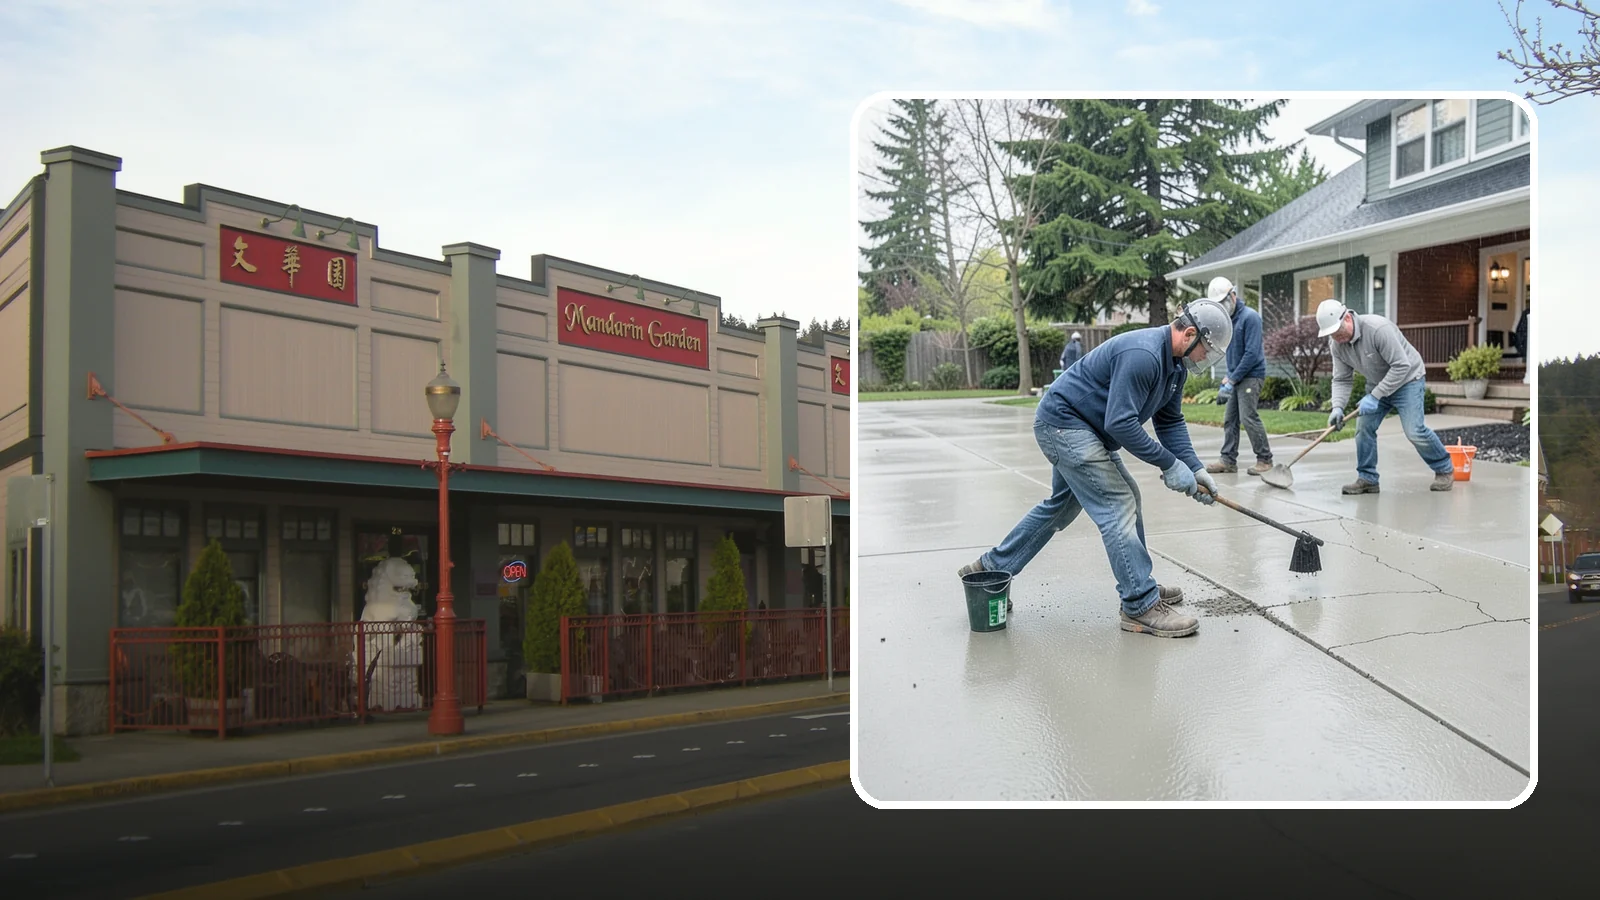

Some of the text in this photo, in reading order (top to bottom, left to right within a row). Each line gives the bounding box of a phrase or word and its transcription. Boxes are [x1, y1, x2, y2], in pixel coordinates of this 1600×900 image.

[231, 235, 346, 291] 文華園
[564, 302, 702, 352] Mandarin Garden
[503, 565, 527, 578] OPEN
